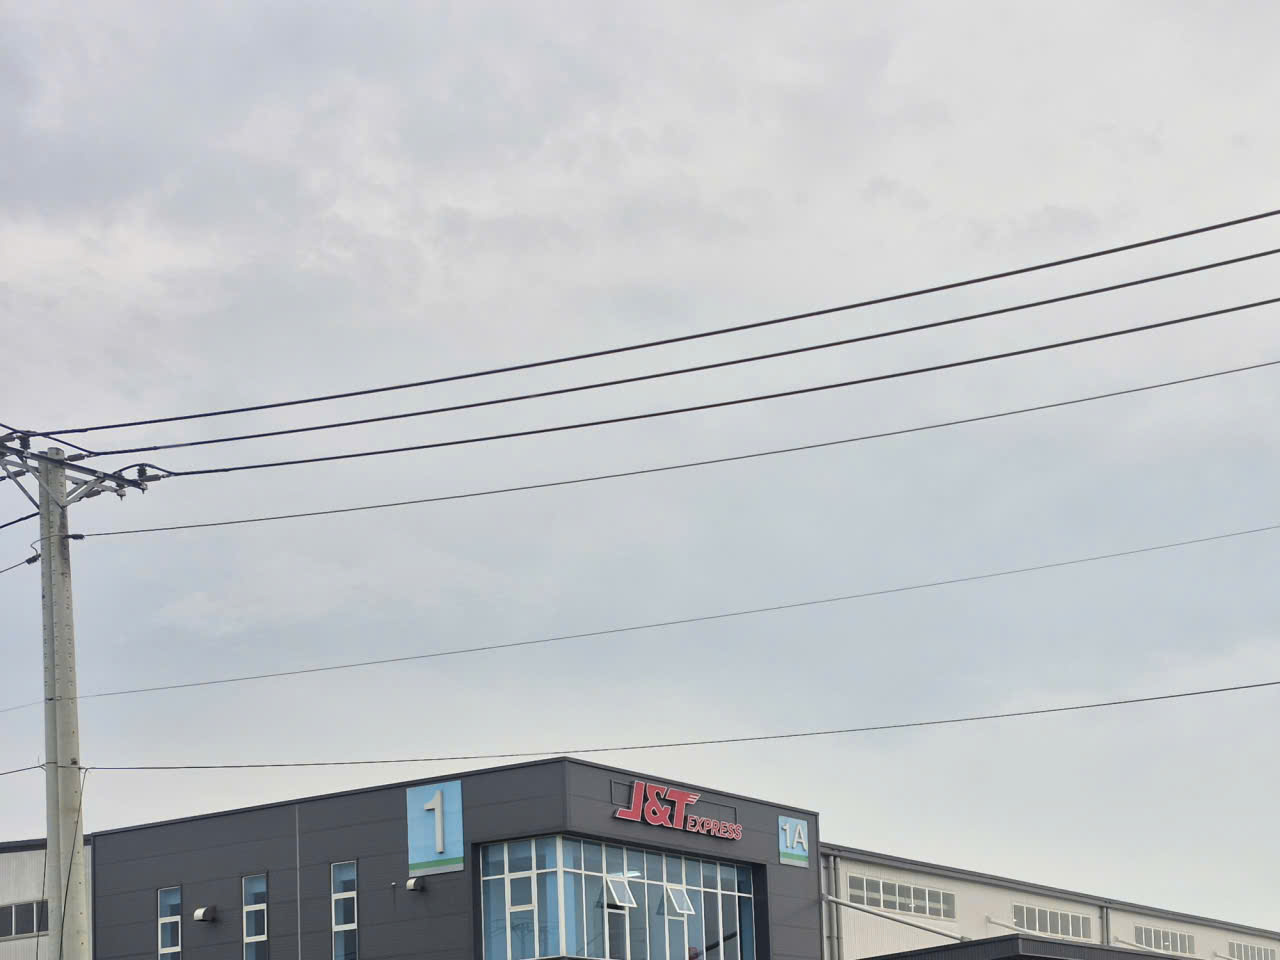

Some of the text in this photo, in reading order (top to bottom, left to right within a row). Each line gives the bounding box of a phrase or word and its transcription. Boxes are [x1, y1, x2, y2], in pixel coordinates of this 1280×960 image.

[424, 789, 444, 853] 1
[616, 781, 743, 840] J&T EXPRESS
[781, 823, 807, 852] 1A
